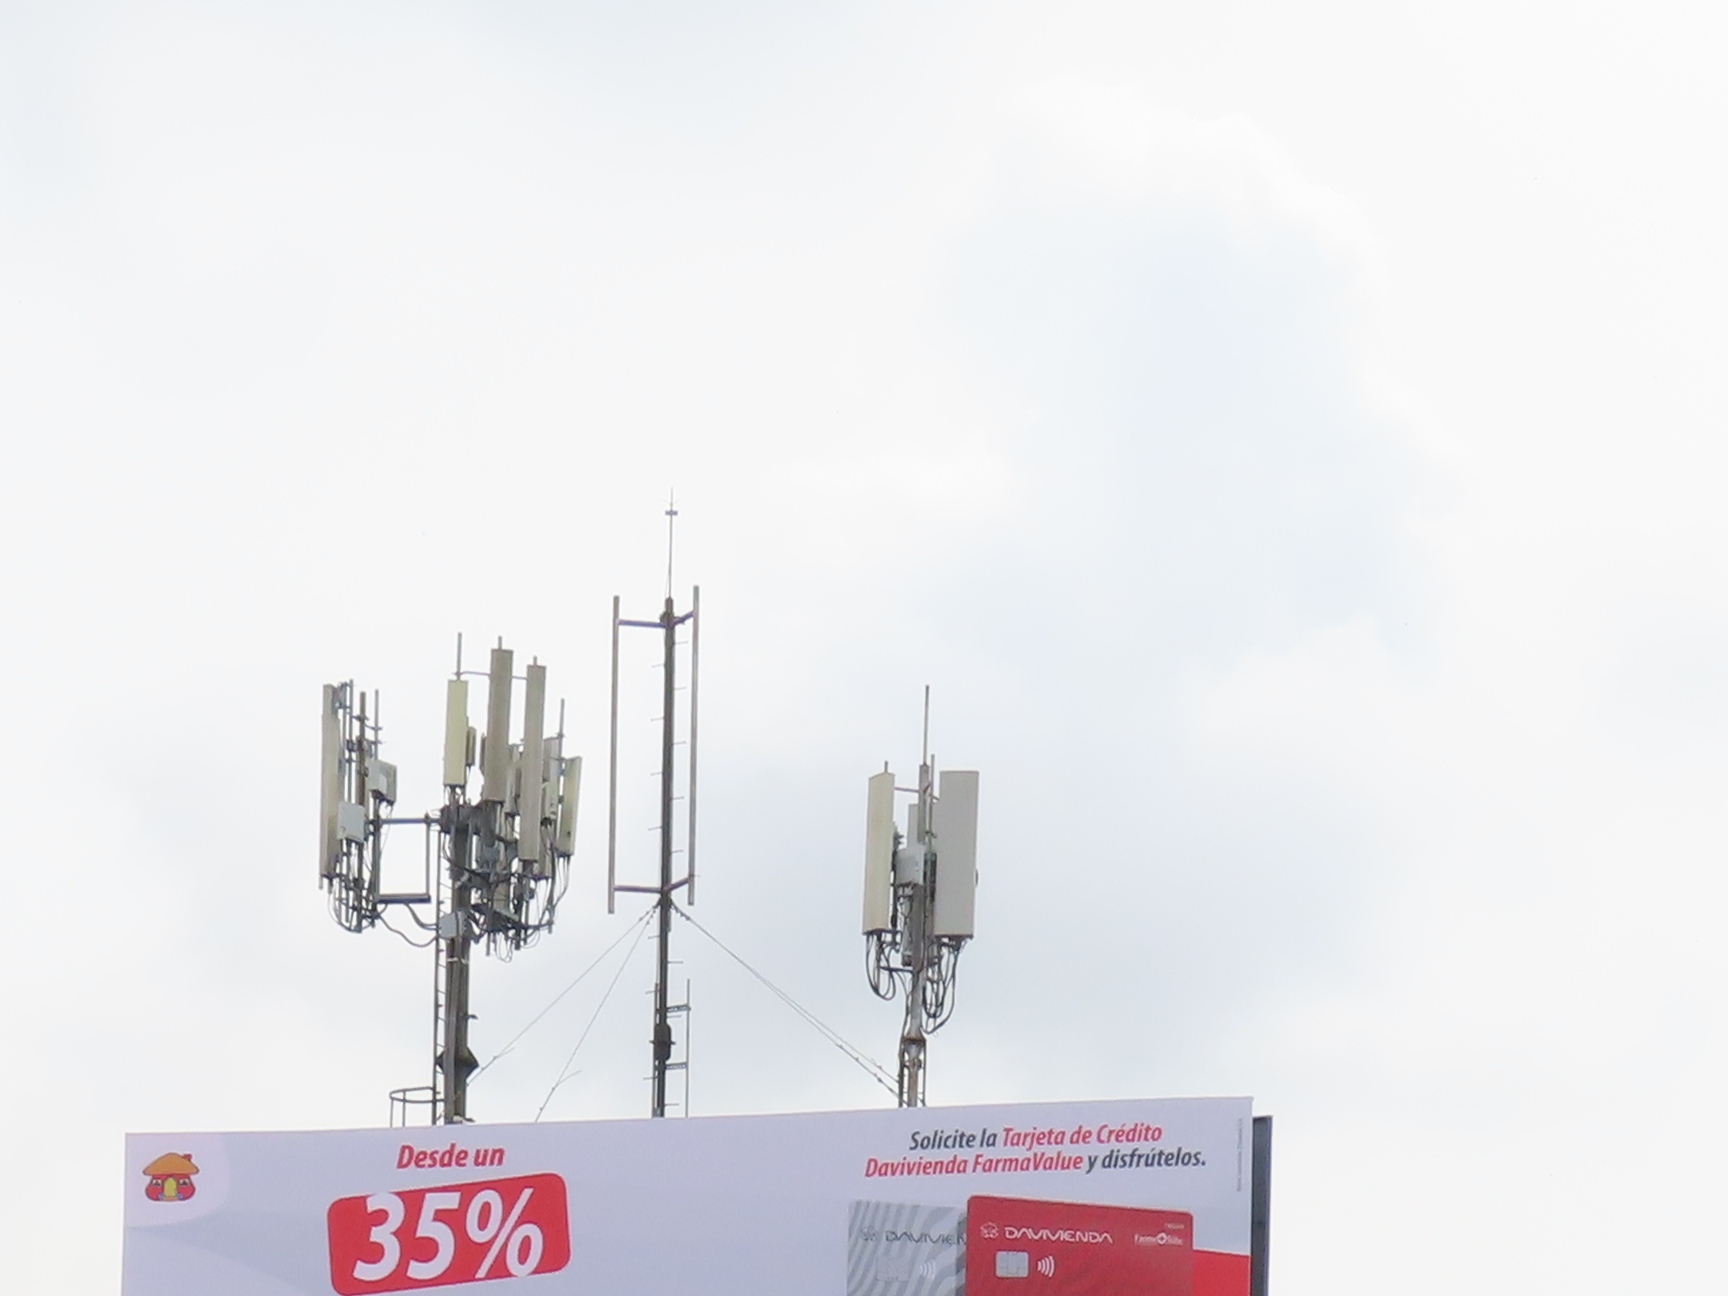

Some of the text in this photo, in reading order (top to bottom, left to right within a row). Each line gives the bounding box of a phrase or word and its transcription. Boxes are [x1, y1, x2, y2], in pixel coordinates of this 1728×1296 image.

[909, 1122, 1163, 1152] Solicite la Tarjeta de Crédito
[396, 1144, 505, 1170] Desde un
[864, 1147, 1206, 1178] Davivienda FarmaValue y disfrútelos.
[352, 1187, 544, 1282] 35%
[1004, 1226, 1114, 1245] DAVIVIENDA
